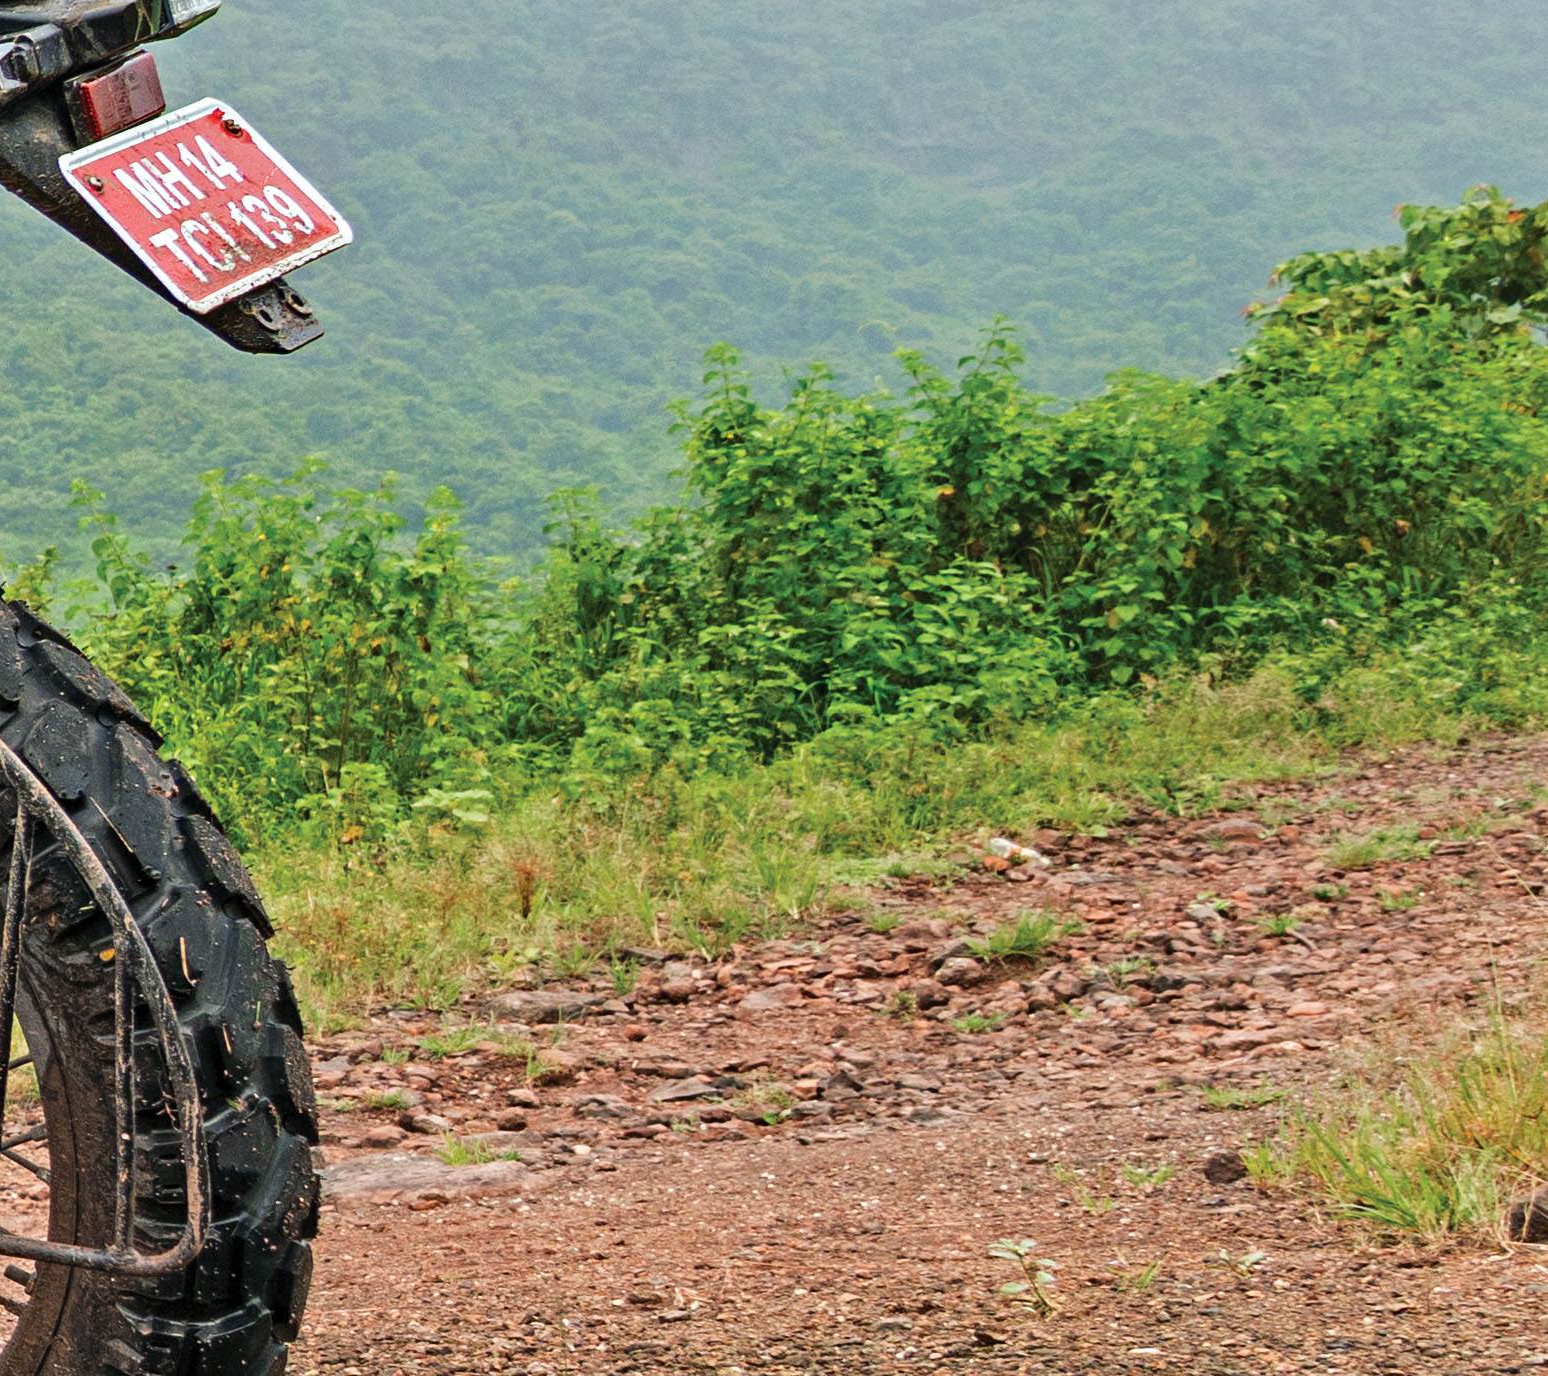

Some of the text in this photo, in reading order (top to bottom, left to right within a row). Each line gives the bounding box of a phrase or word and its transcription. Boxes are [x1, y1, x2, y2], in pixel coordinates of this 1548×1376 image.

[113, 135, 243, 219] MH 14
[228, 185, 316, 249] 139
